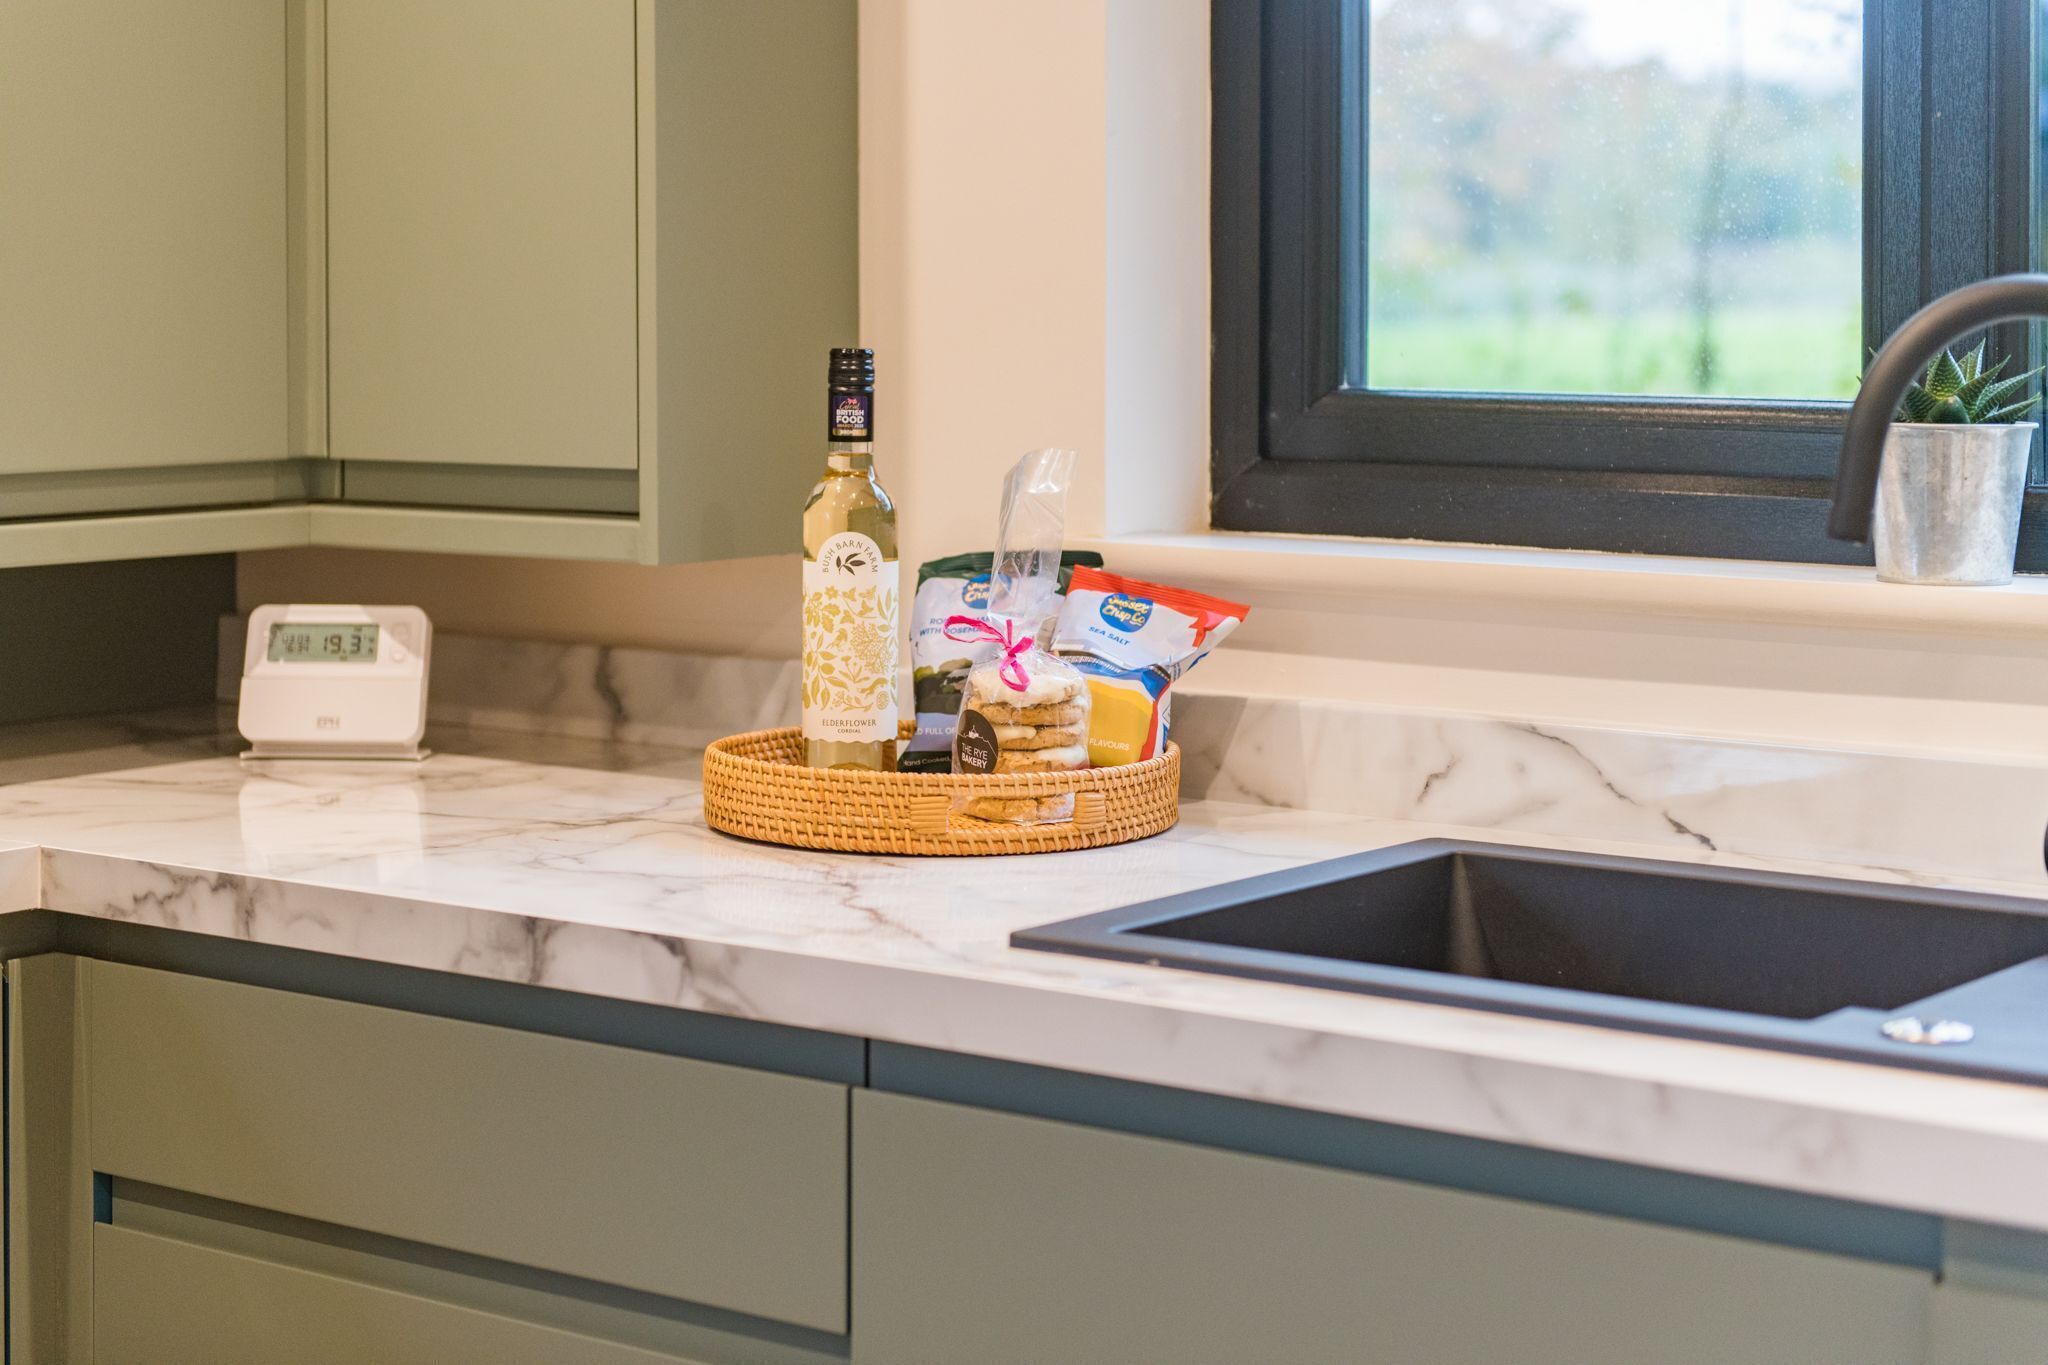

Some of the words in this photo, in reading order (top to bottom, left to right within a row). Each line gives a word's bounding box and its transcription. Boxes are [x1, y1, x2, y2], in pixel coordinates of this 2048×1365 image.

[836, 416, 864, 424] FOOD
[822, 547, 836, 573] BUSH
[836, 539, 863, 550] BARN
[863, 546, 878, 573] FARM
[920, 626, 942, 637] WITH
[1088, 626, 1106, 636] SEA
[1107, 632, 1131, 646] SALT
[323, 633, 362, 655] 19.3
[822, 719, 877, 727] ELDERFLOWER
[925, 727, 943, 736] FULL
[961, 742, 973, 756] THE
[973, 748, 988, 761] RYE
[1089, 737, 1131, 752] FLAVOURS
[961, 752, 988, 769] BAKERY
